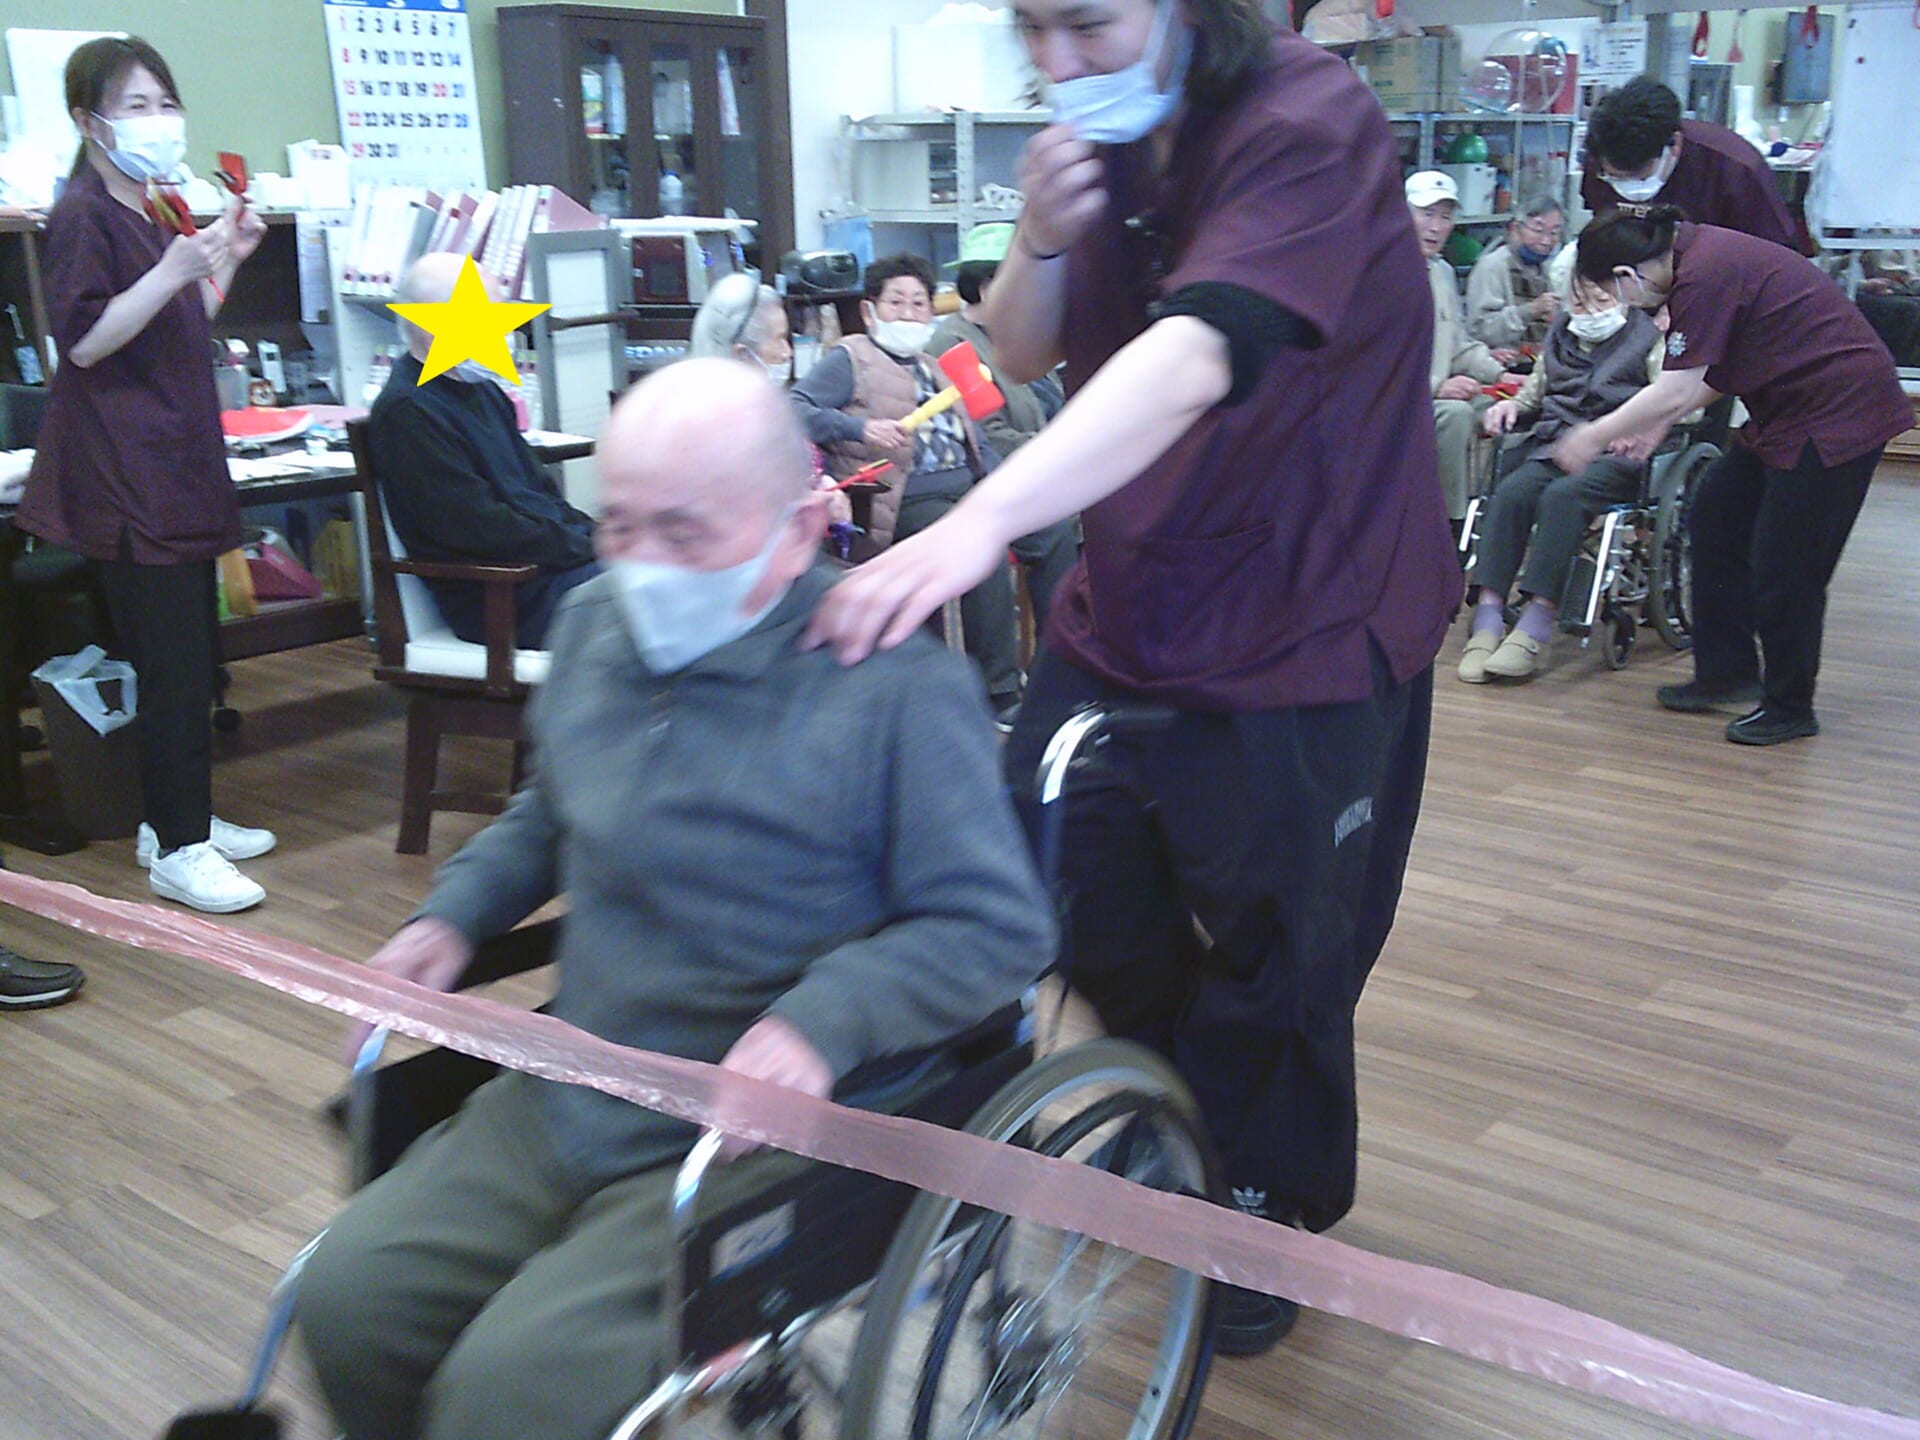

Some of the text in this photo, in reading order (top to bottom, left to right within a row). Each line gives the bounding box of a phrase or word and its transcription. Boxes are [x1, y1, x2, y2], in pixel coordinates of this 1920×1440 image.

[357, 17, 365, 32] 2
[375, 18, 383, 33] 3
[394, 19, 401, 33] 4
[412, 20, 420, 35] 5
[430, 22, 438, 36] 6
[448, 22, 456, 37] 7
[343, 48, 350, 63] 8
[360, 49, 368, 63] 9
[376, 49, 389, 64] 10
[412, 51, 425, 66] 12
[430, 52, 443, 67] 13
[448, 53, 461, 67] 14
[343, 80, 356, 96] 15
[360, 80, 374, 96] 16
[379, 81, 391, 97] 17
[397, 81, 409, 97] 18
[415, 82, 428, 97] 19
[433, 83, 446, 97] 20
[348, 112, 361, 127] 22
[365, 112, 378, 127] 23
[382, 112, 396, 127] 24
[400, 113, 413, 128] 25
[418, 113, 431, 128] 26
[436, 113, 449, 128] 27
[351, 143, 364, 158] 29
[367, 143, 381, 158] 30
[386, 143, 399, 158] 31
